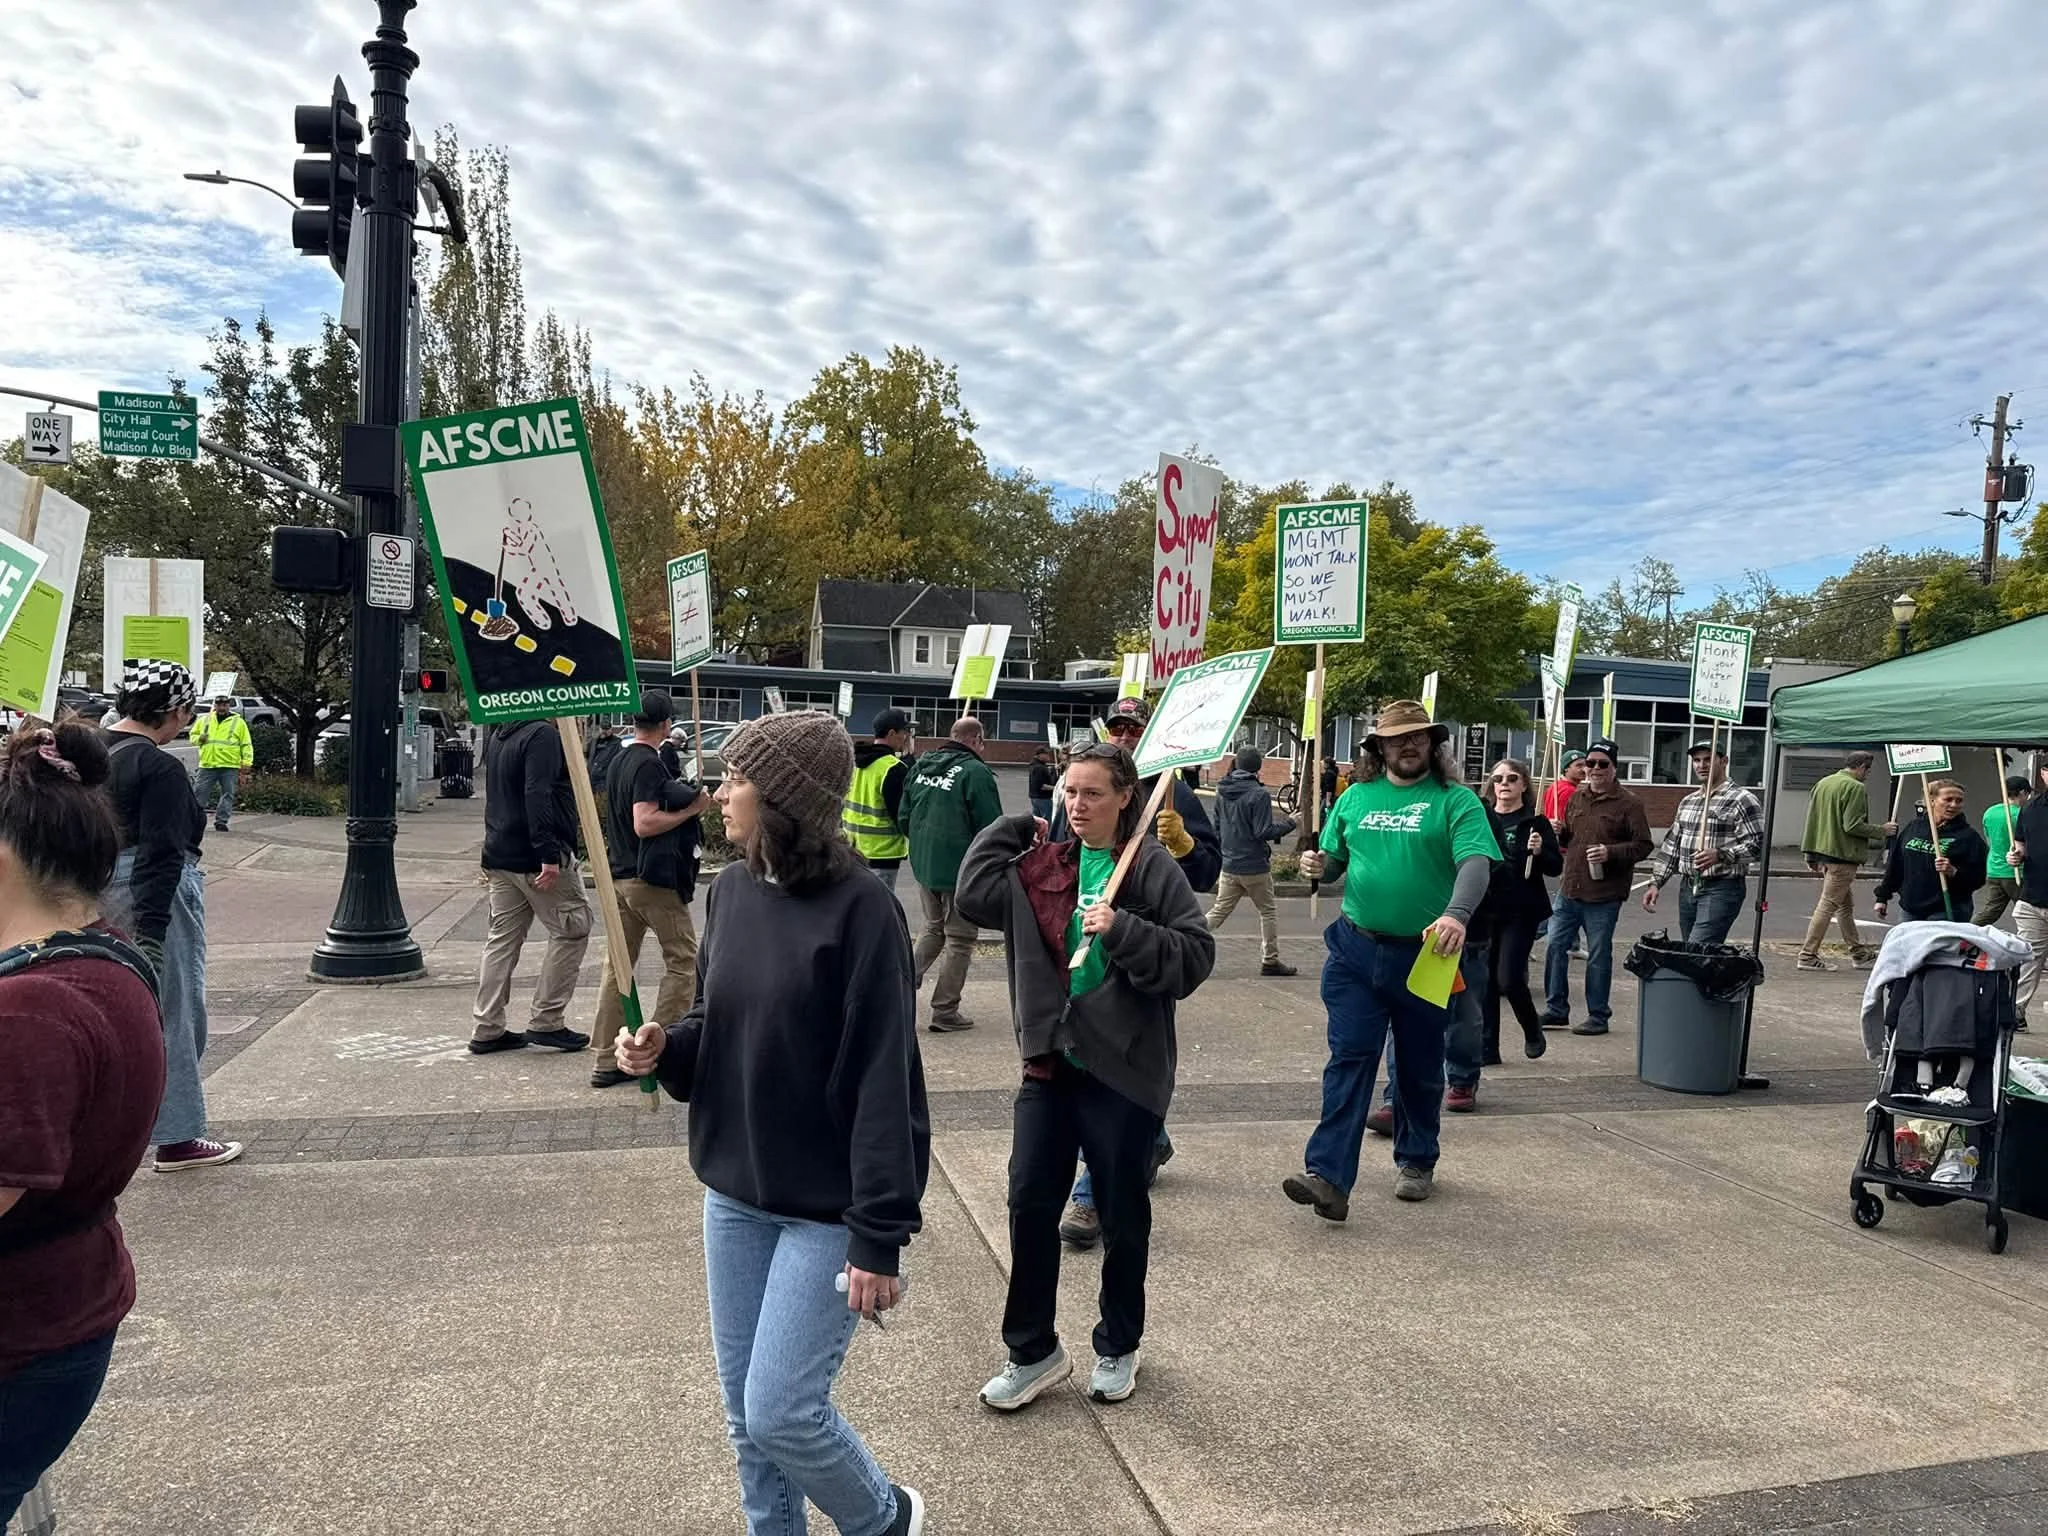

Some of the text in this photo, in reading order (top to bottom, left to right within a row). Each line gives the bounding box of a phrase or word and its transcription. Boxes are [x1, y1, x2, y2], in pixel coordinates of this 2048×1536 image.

[114, 396, 163, 409] Madison
[32, 417, 61, 431] ONE
[103, 413, 152, 426] City Hall
[32, 430, 62, 443] WAY
[103, 428, 180, 442] Municipal Court
[419, 409, 577, 468] AFSCME
[104, 441, 192, 458] Madison Av Bldg
[1158, 463, 1218, 566] Support
[1283, 507, 1361, 529] AFSCME
[1288, 527, 1350, 552] MGMT
[1328, 549, 1357, 565] TALK
[671, 556, 705, 581] AFSCME
[1284, 571, 1337, 589] SO WE
[1157, 566, 1202, 637] City
[1284, 586, 1332, 605] MUST
[1289, 607, 1336, 622] WALK!
[1282, 627, 1312, 635] OREGON
[1313, 626, 1345, 634] COUNCIL
[1700, 627, 1748, 643] AFSCME
[1703, 642, 1738, 658] Honk
[1177, 654, 1264, 683] AFSCME
[1700, 668, 1733, 680] Water
[478, 683, 631, 709] OREGON COUNCIL 75
[1360, 814, 1423, 827] AFSCME
